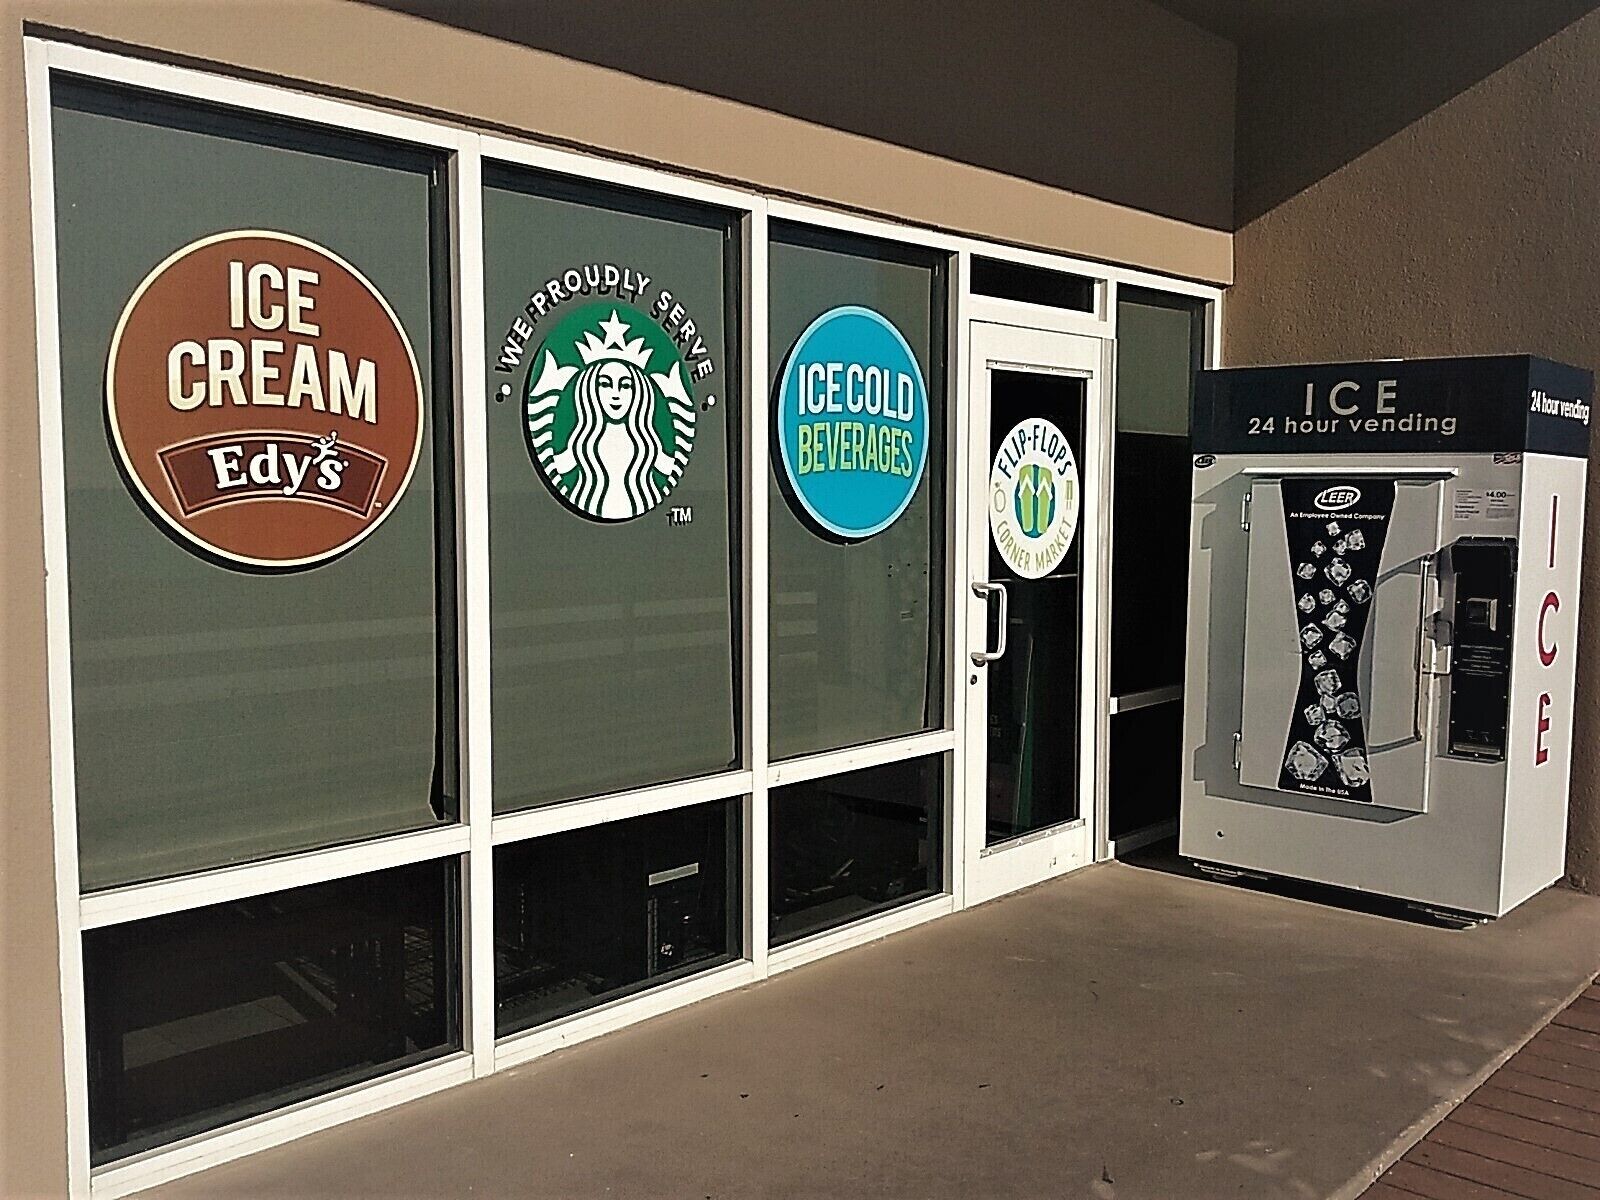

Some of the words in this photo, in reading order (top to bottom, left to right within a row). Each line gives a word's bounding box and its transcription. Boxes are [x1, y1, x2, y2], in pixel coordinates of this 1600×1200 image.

[229, 260, 321, 337] ICE
[500, 316, 533, 368] WE
[531, 264, 651, 315] PROUDLY
[656, 291, 714, 378] SERVE
[167, 338, 379, 424] CREAM
[798, 362, 844, 416] ICE
[846, 363, 914, 422] COLD
[1305, 380, 1397, 416] ICE
[1531, 390, 1541, 412] 24
[1542, 392, 1560, 415] hour
[1560, 399, 1590, 425] vending
[798, 421, 913, 478] BEVERAGES
[997, 424, 1072, 479] FLIP-FLOPS
[1248, 416, 1275, 434] 24
[1285, 416, 1340, 434] hour
[1349, 413, 1457, 436] vending
[207, 431, 344, 496] Edy's
[671, 507, 693, 523] TM
[1320, 489, 1355, 504] LEER
[1353, 513, 1386, 521] Company
[996, 520, 1031, 572] CORNER
[1035, 516, 1073, 572] MARKET
[1534, 494, 1561, 767] ICE
